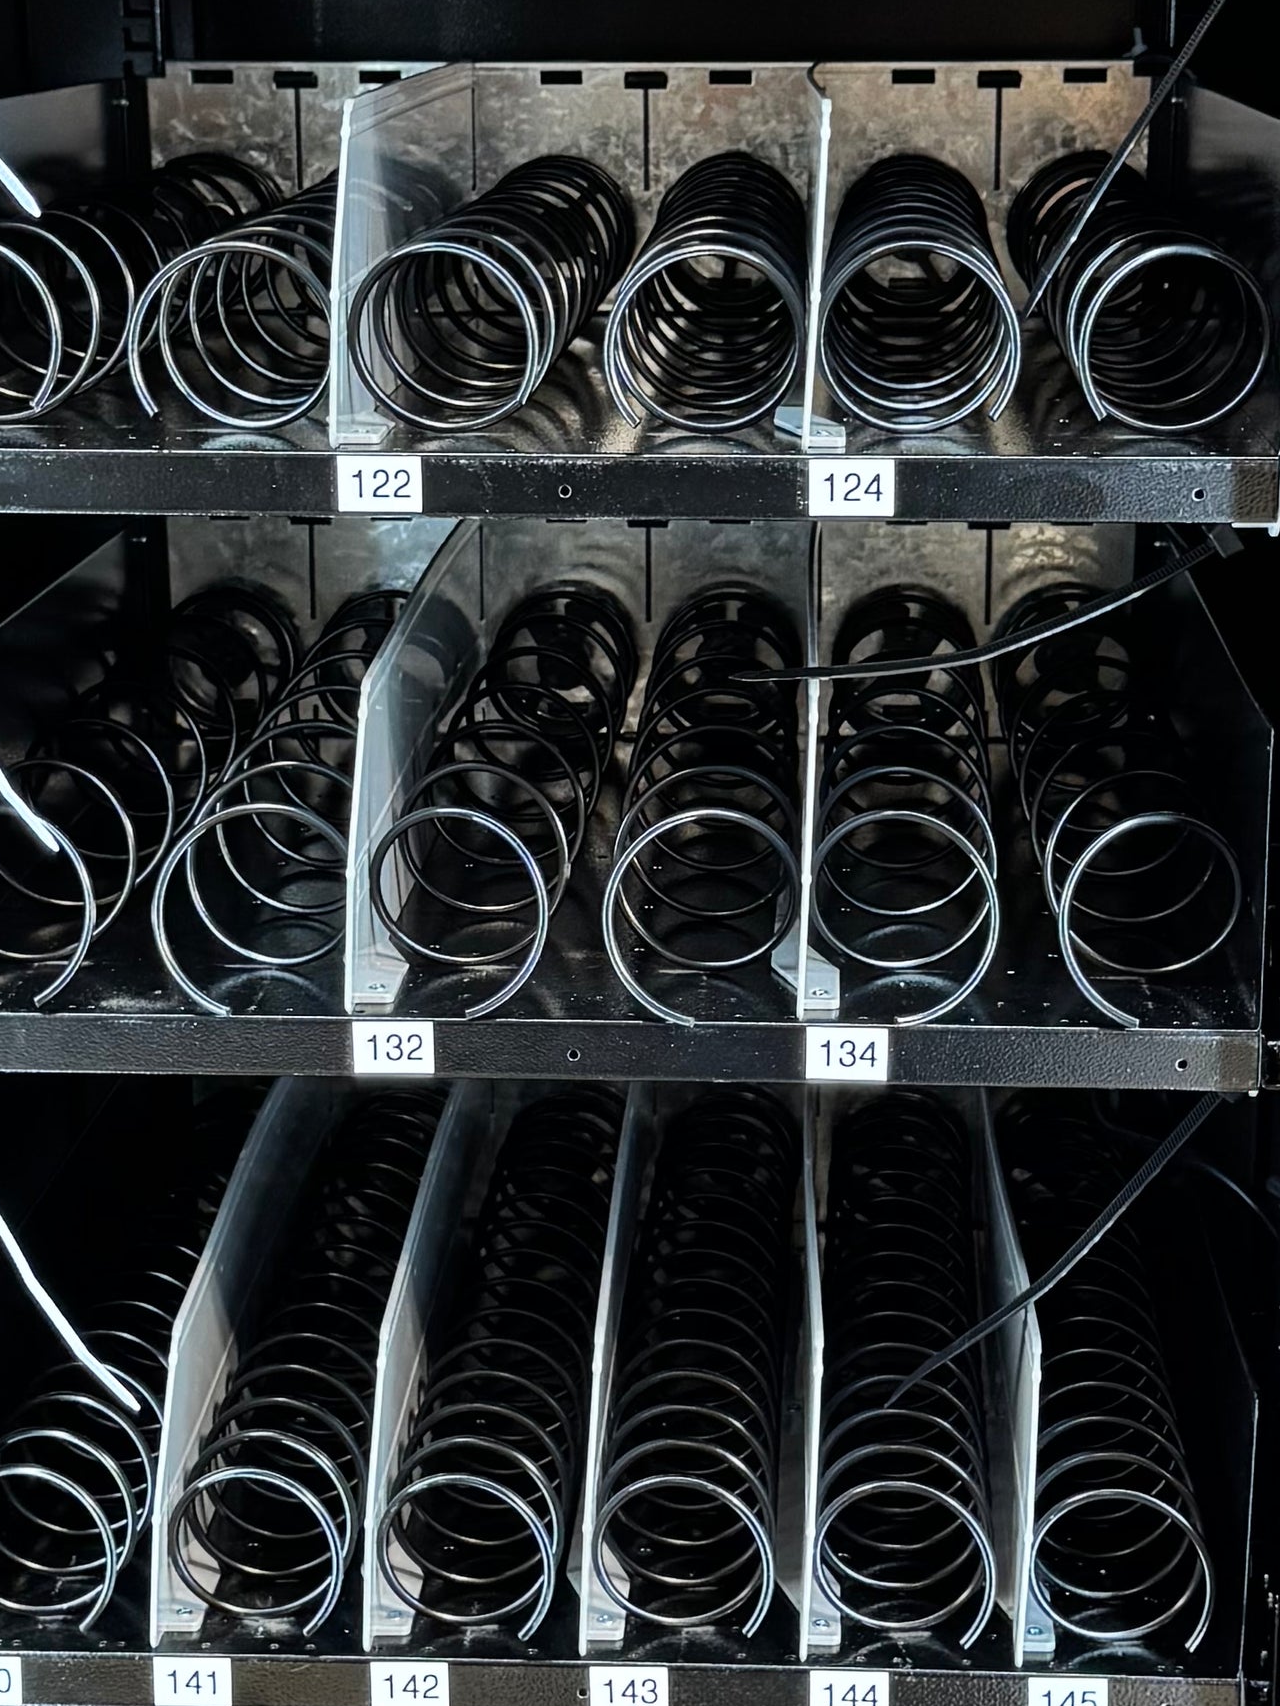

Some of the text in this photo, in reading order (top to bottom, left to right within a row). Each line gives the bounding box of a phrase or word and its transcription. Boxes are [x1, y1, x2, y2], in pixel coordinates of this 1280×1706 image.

[352, 469, 411, 499] 122
[824, 473, 883, 503] 124
[367, 1034, 423, 1062] 132
[820, 1039, 877, 1068] 134
[167, 1670, 217, 1695] 141
[384, 1674, 439, 1700] 142
[604, 1678, 659, 1704] 143
